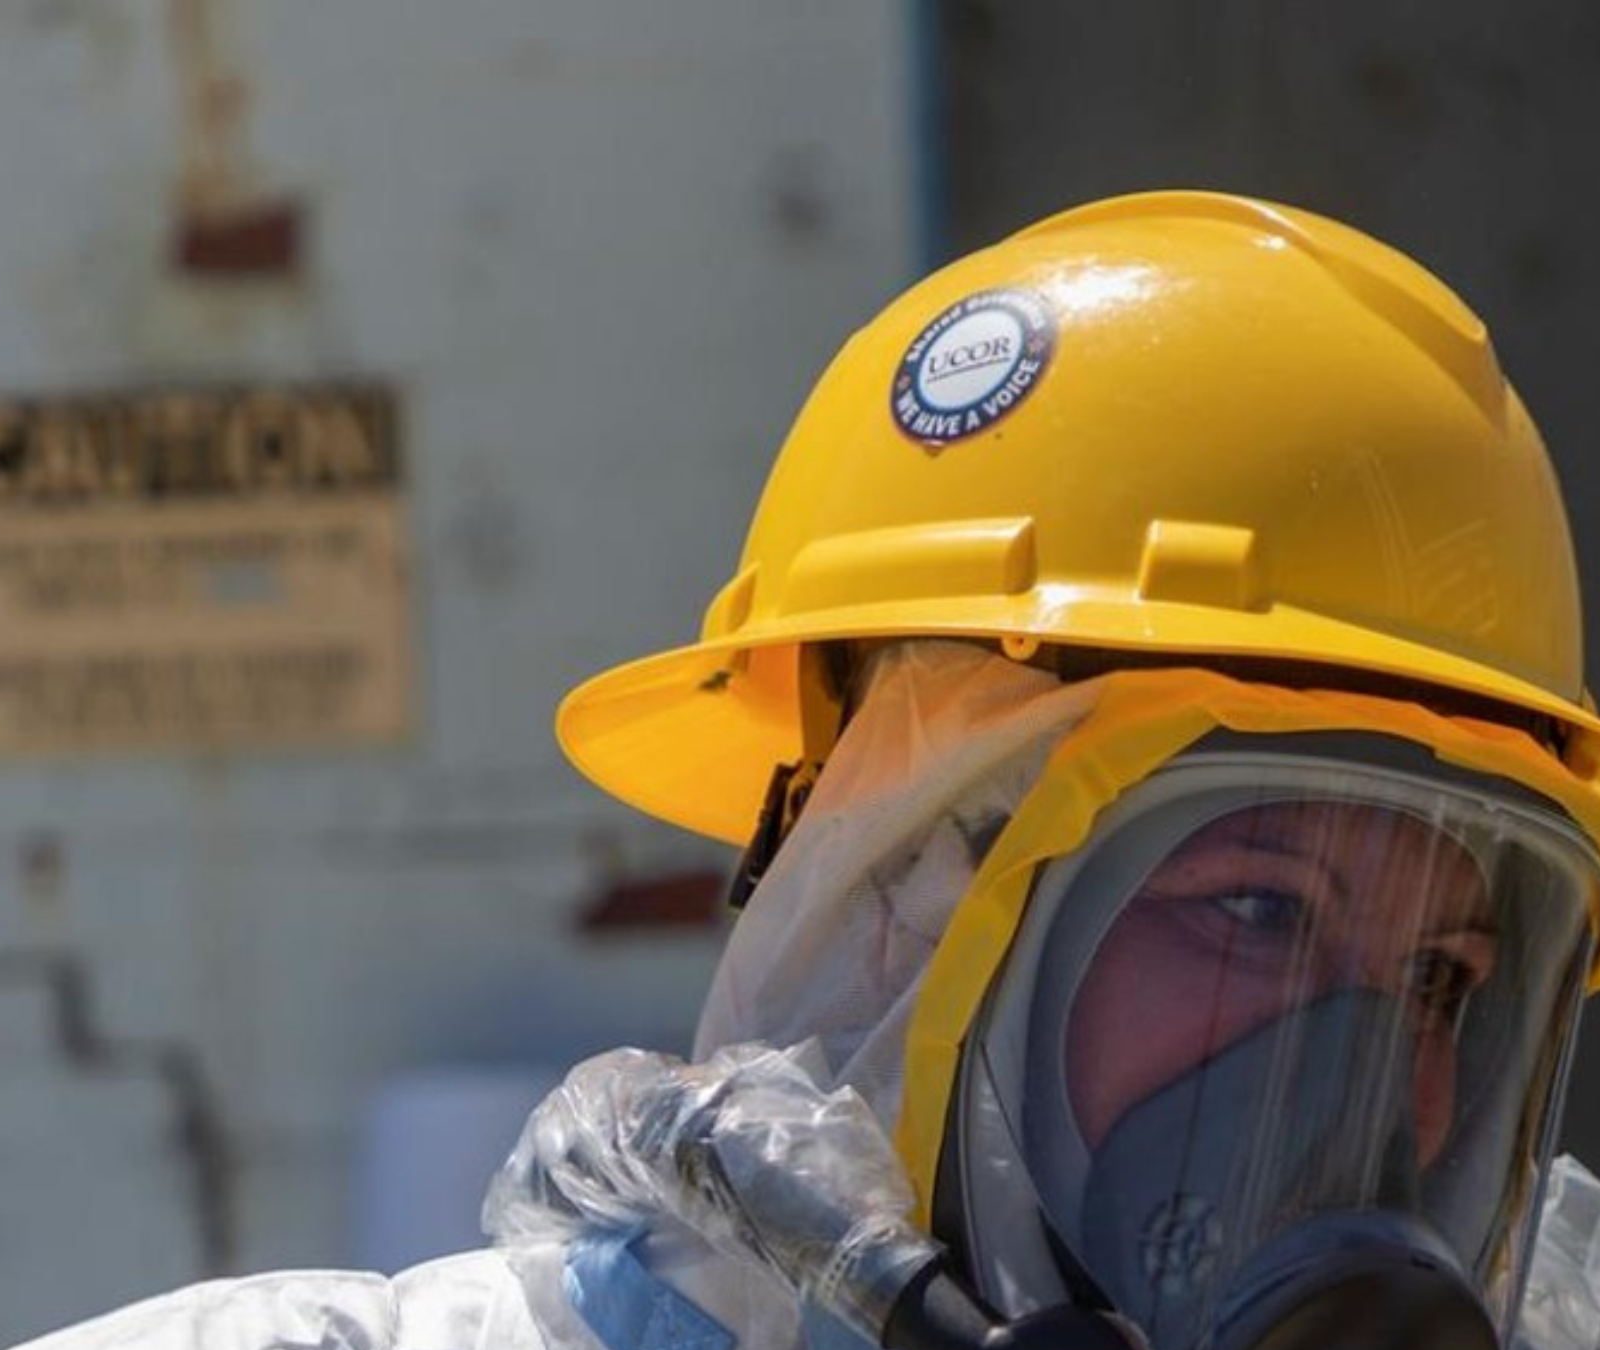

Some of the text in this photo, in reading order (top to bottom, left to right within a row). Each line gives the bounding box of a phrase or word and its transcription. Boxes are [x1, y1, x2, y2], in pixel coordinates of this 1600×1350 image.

[928, 336, 1011, 375] UCOR
[896, 390, 921, 424] WE
[965, 410, 981, 431] A
[983, 360, 1040, 417] VOICE
